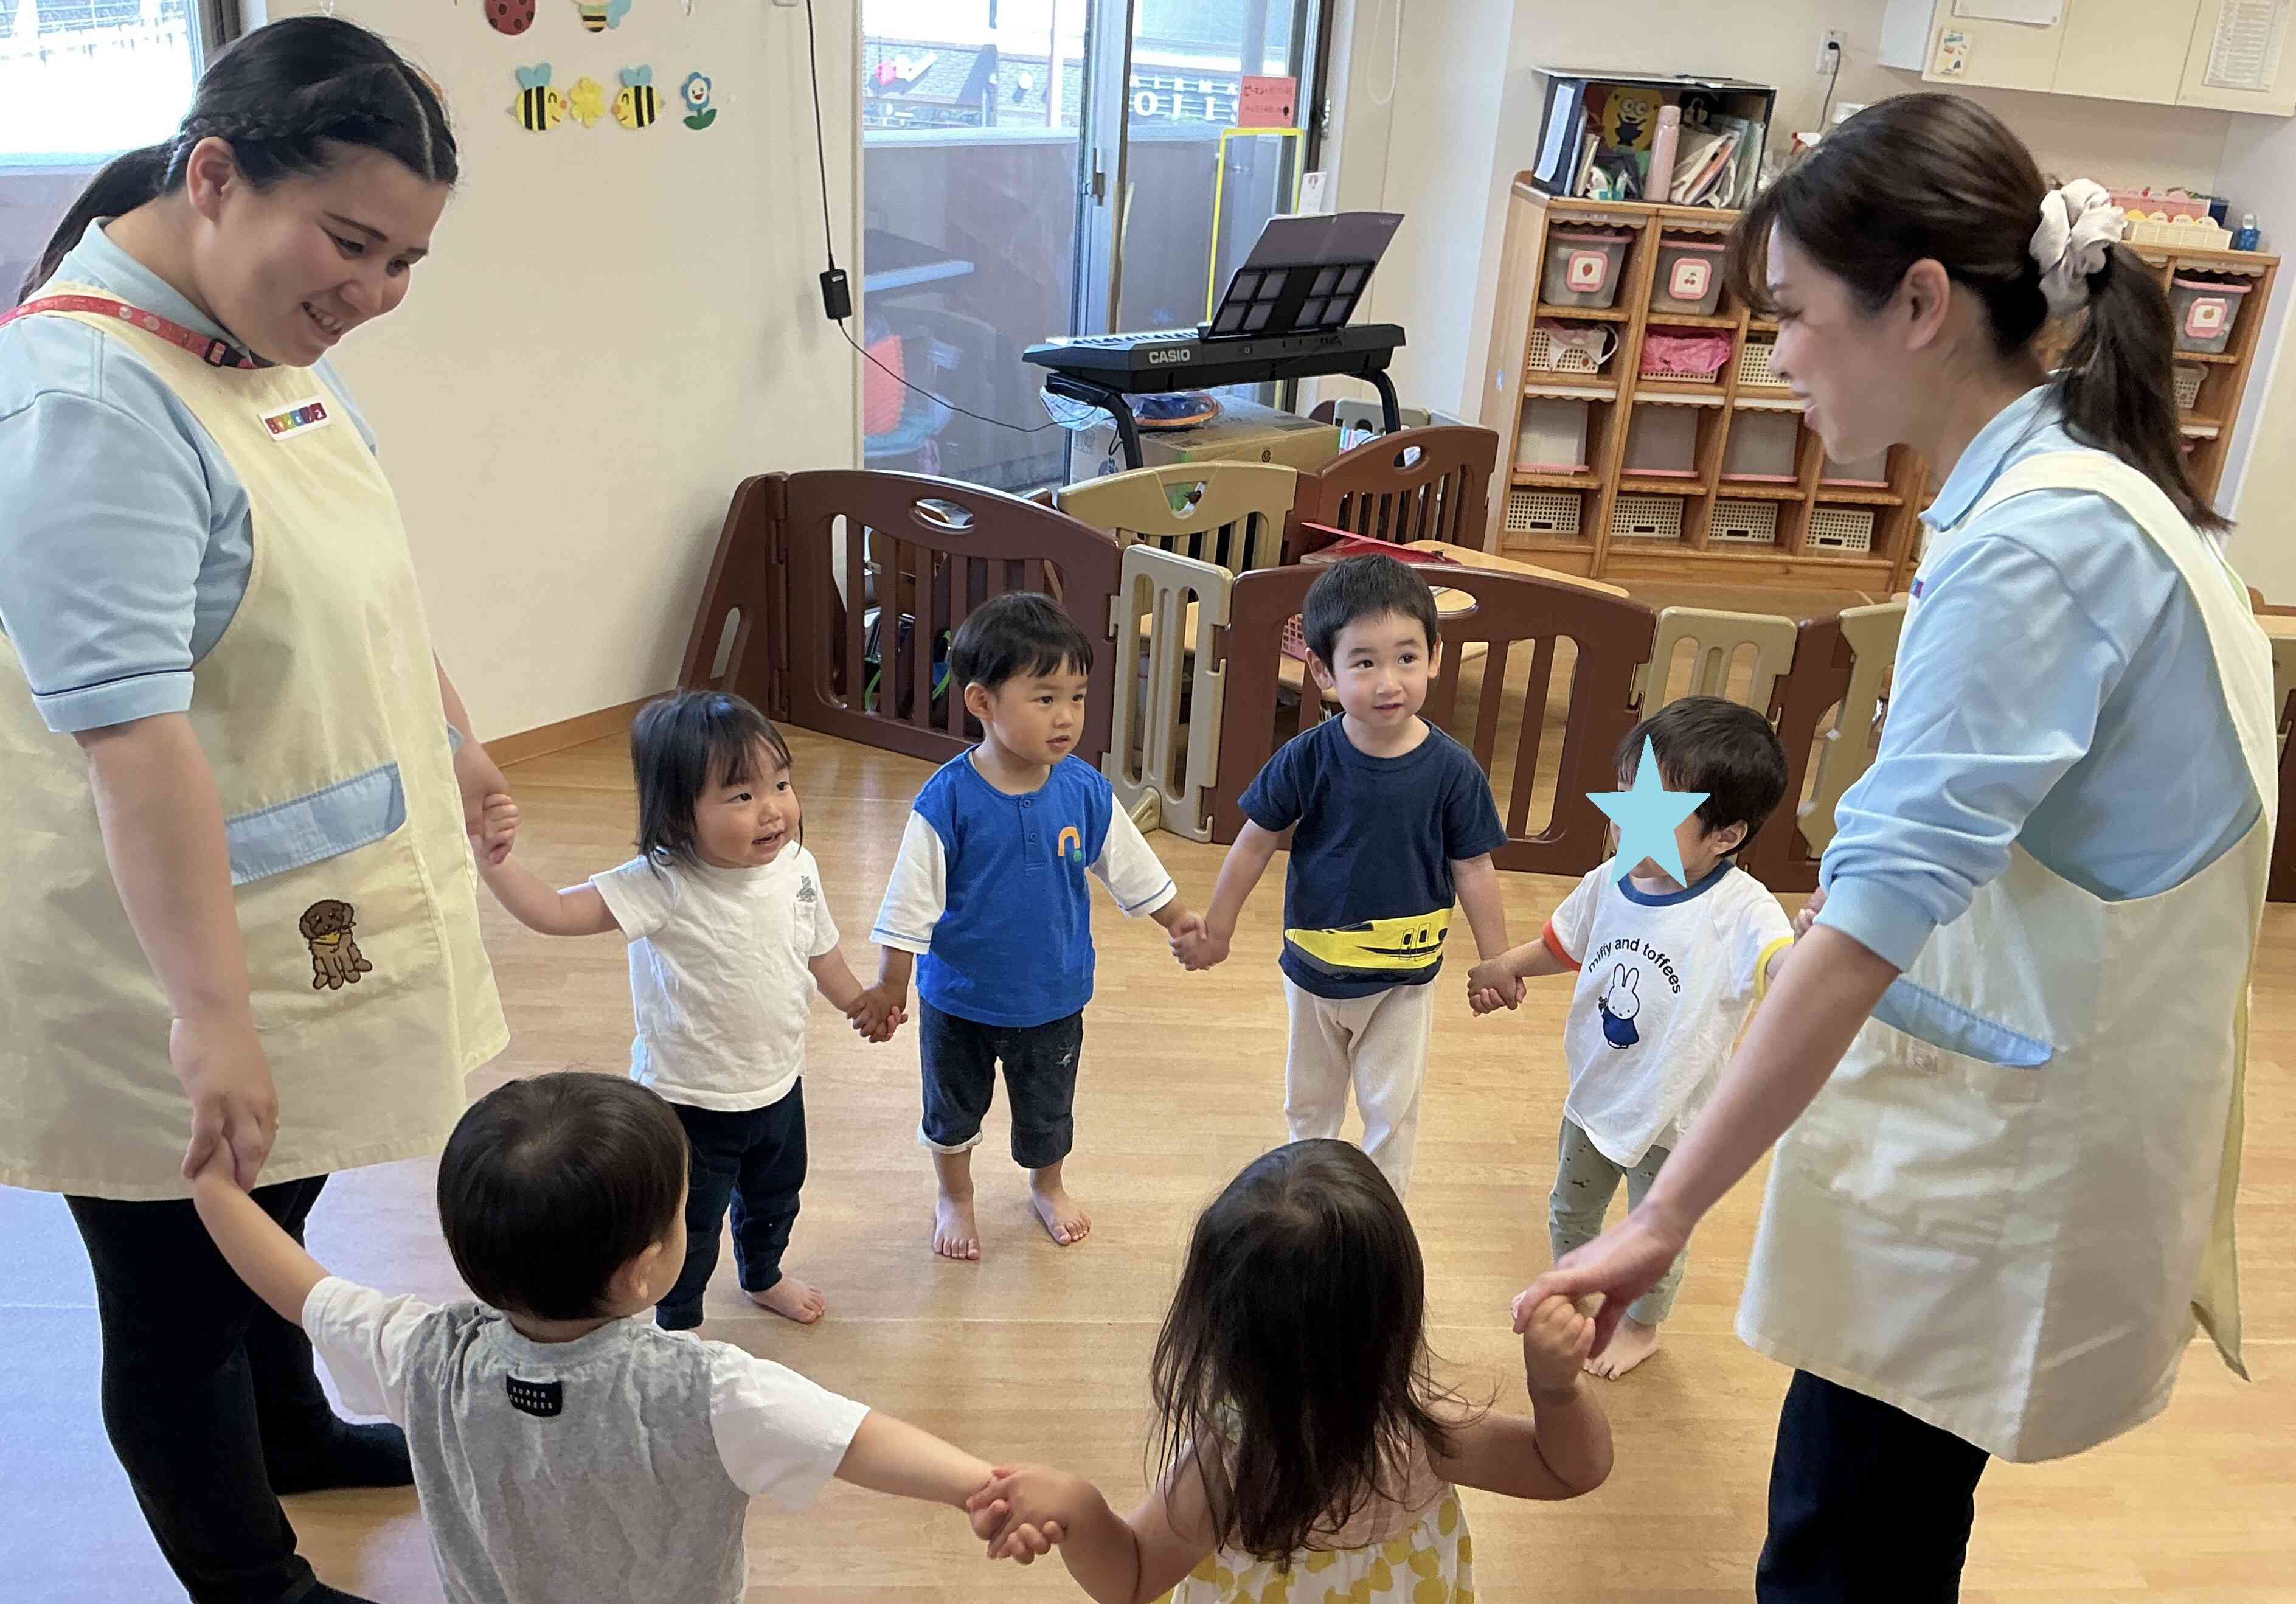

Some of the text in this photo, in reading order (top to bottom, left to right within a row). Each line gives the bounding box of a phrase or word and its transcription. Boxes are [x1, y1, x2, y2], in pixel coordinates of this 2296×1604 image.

[1148, 349, 1190, 364] CASIO
[1588, 938, 1681, 994] miffy and toffees
